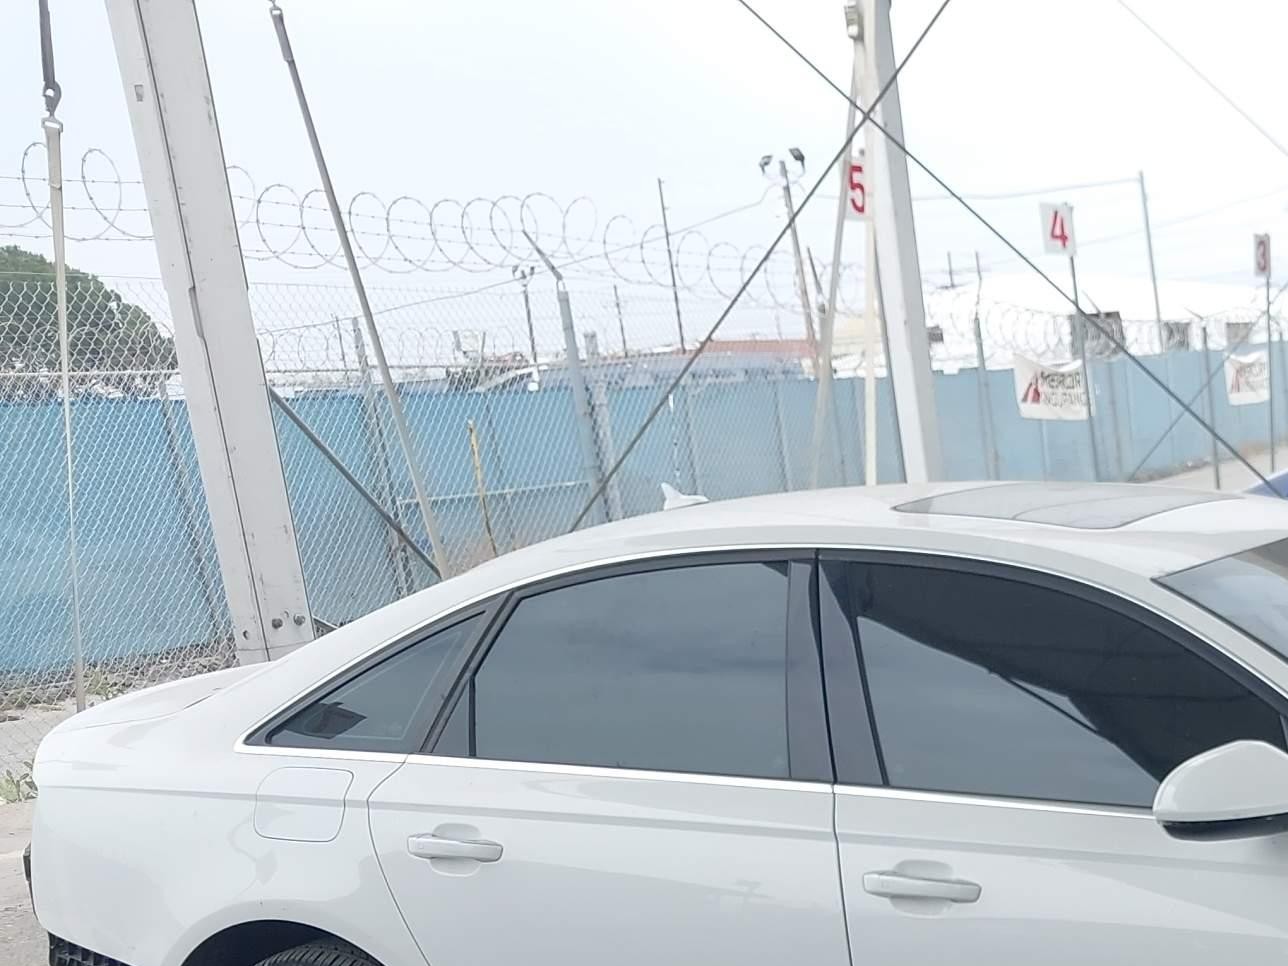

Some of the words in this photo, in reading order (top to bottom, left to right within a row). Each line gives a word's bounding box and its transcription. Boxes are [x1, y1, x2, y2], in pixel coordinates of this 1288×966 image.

[849, 165, 865, 214] 5
[1050, 210, 1069, 249] 4
[1256, 240, 1268, 272] 3
